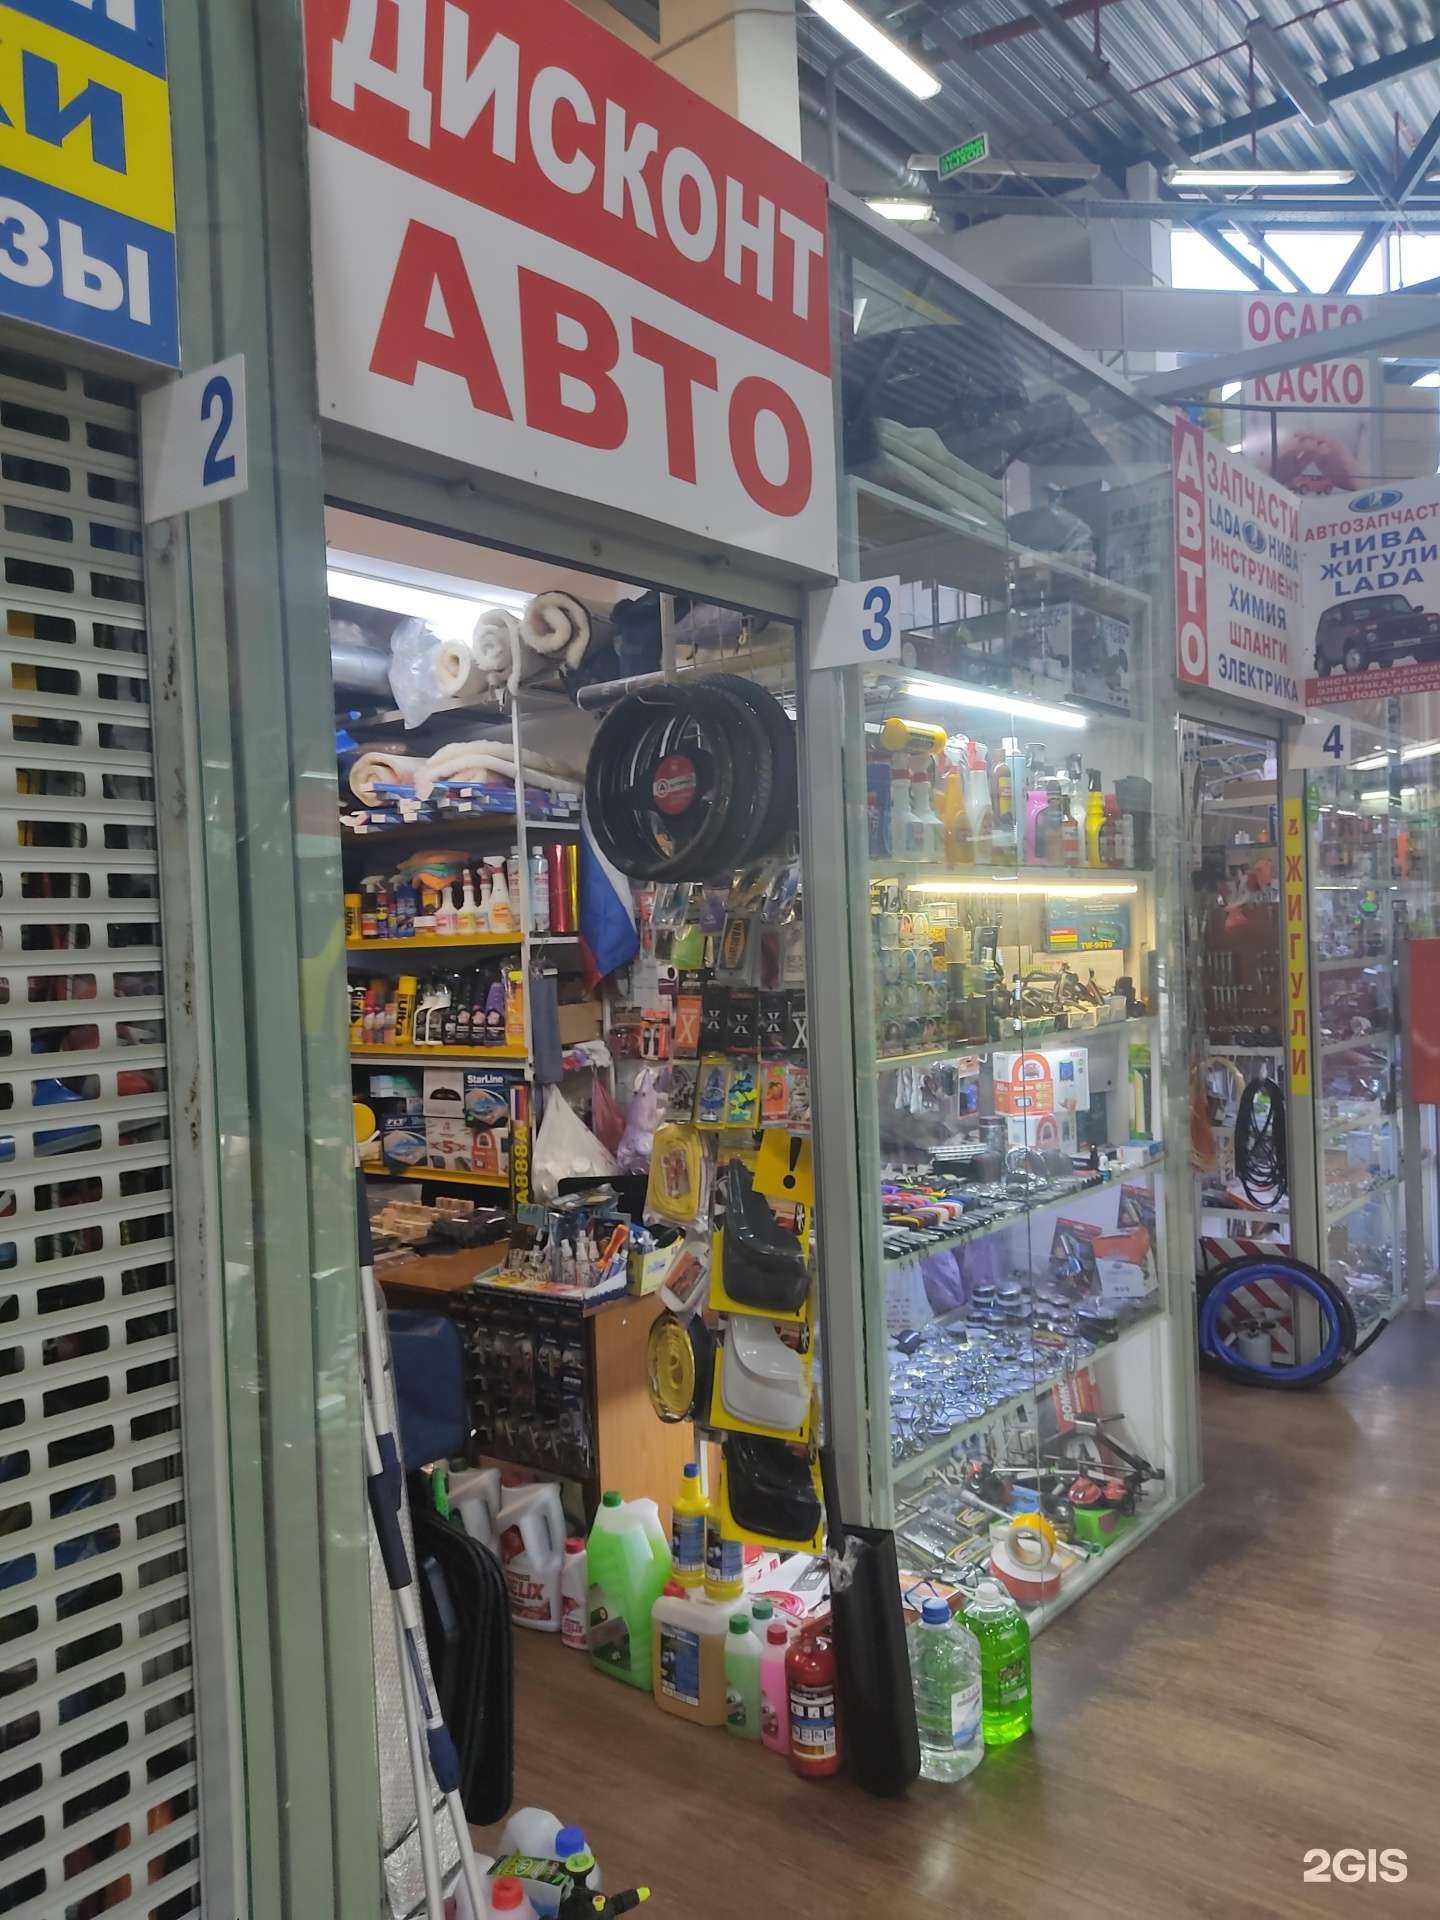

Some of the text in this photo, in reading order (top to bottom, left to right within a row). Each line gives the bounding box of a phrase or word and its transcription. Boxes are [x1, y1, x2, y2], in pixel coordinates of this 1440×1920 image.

[0, 49, 127, 175] И
[330, 0, 824, 321] ДИСКОНТ
[368, 217, 813, 518] АВТО
[1254, 361, 1364, 405] КАСКО
[201, 375, 236, 488] 2
[1207, 451, 1298, 543] ЗАПЧАСТИ
[1176, 431, 1206, 677] АВТО
[1209, 497, 1299, 573] LADA НИВА
[1320, 544, 1438, 581] ЖИГУЛИ
[1330, 526, 1427, 558] НИВА
[1210, 535, 1299, 603] ИНСТРУМЕНТ
[1335, 567, 1425, 597] LADA
[861, 585, 893, 652] 3
[1229, 583, 1287, 631] ХИМИЯ
[1229, 621, 1288, 665] ШЛАНГИ
[1218, 653, 1299, 702] ЭЛЕКТРИКА
[1322, 724, 1345, 759] 4
[1286, 855, 1306, 1076] ЖИГУЛИ
[395, 1000, 407, 1036] Ultra
[467, 1074, 504, 1085] StarLine
